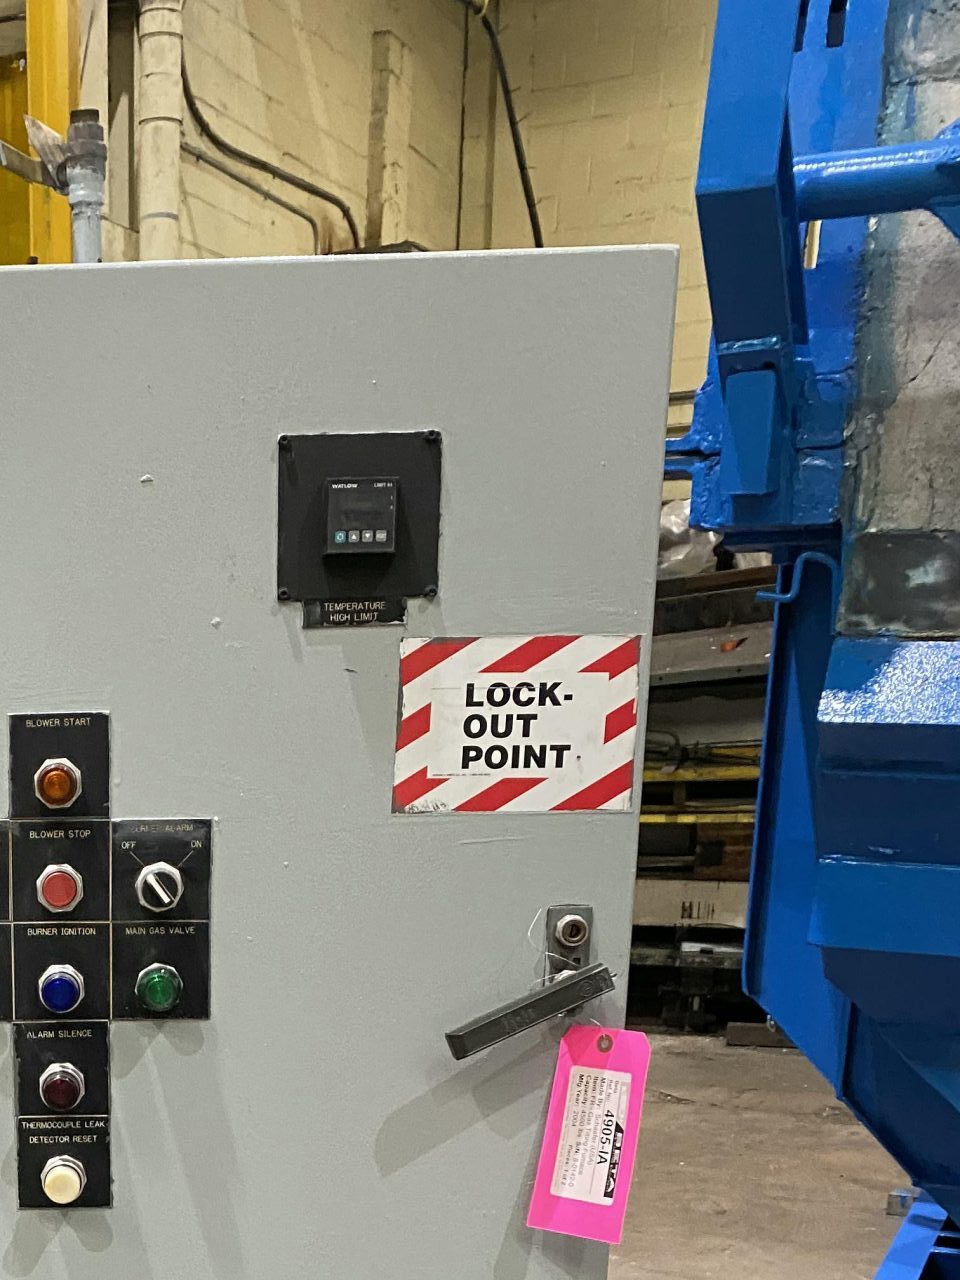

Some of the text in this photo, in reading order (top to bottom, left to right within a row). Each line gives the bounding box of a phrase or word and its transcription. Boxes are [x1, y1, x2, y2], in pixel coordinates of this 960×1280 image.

[324, 602, 386, 611] TEMPERATURE
[330, 612, 379, 622] HIGH LIMIT
[465, 682, 573, 708] LOCK-
[25, 717, 91, 728] BLOWER START
[463, 713, 538, 739] OUT
[461, 744, 572, 770] POINT
[29, 829, 91, 839] BLOWER STOP
[121, 840, 202, 849] OFF ON
[27, 927, 96, 936] BURNER IGNITION
[125, 926, 195, 935] MAIN GAS VALVE
[27, 1029, 92, 1039] ALARM SILENCE
[598, 1077, 607, 1095] Made
[586, 1111, 594, 1124] Gas
[21, 1121, 81, 1130] THERMOCOUPLE
[29, 1135, 97, 1144] DETECTOR RESET
[597, 1109, 615, 1165] 4905-IA
[587, 1145, 596, 1165] (USA)
[578, 1148, 588, 1174] Furnace
